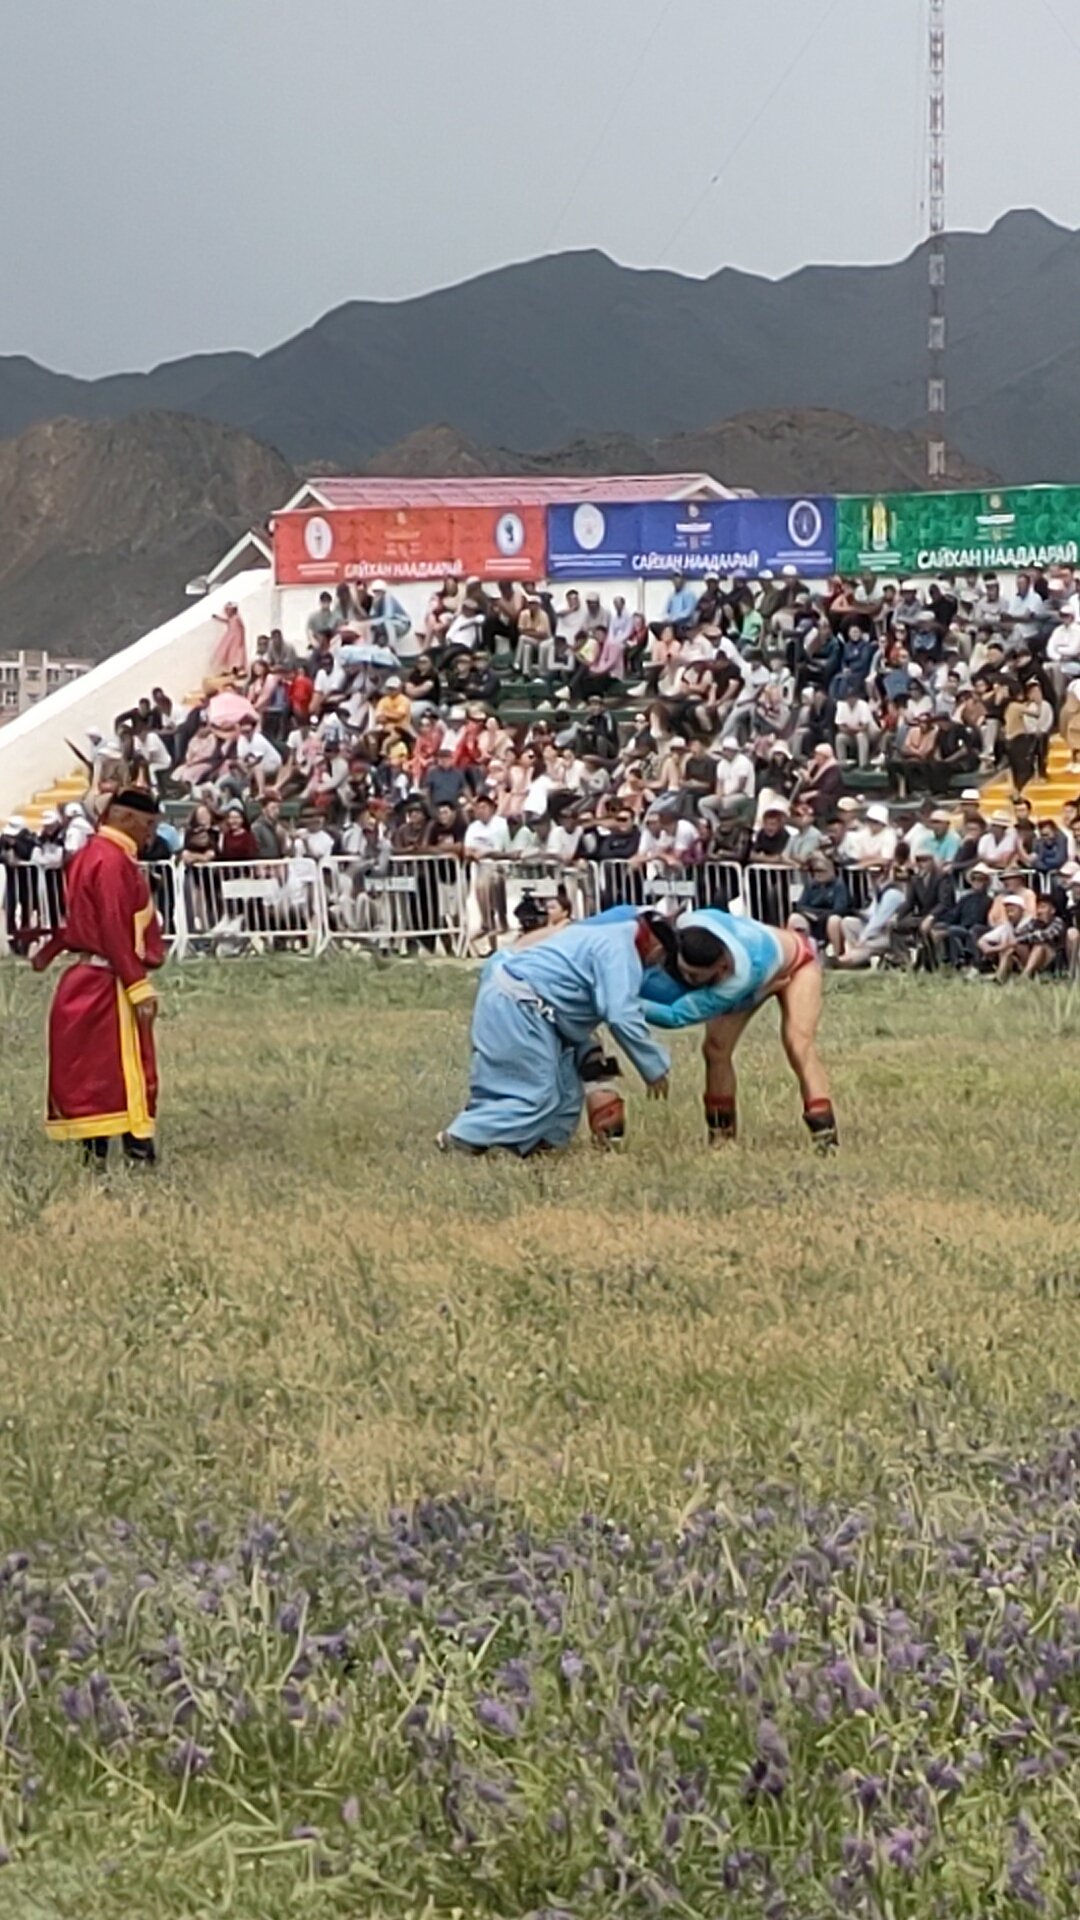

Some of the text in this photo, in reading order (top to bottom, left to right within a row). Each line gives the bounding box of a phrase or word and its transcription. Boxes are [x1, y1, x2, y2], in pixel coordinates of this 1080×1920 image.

[344, 560, 391, 578] САЙХАН
[632, 551, 682, 570] САЙХАН
[684, 549, 759, 571] НААДААРАЙ
[917, 547, 980, 570] САЙХАН
